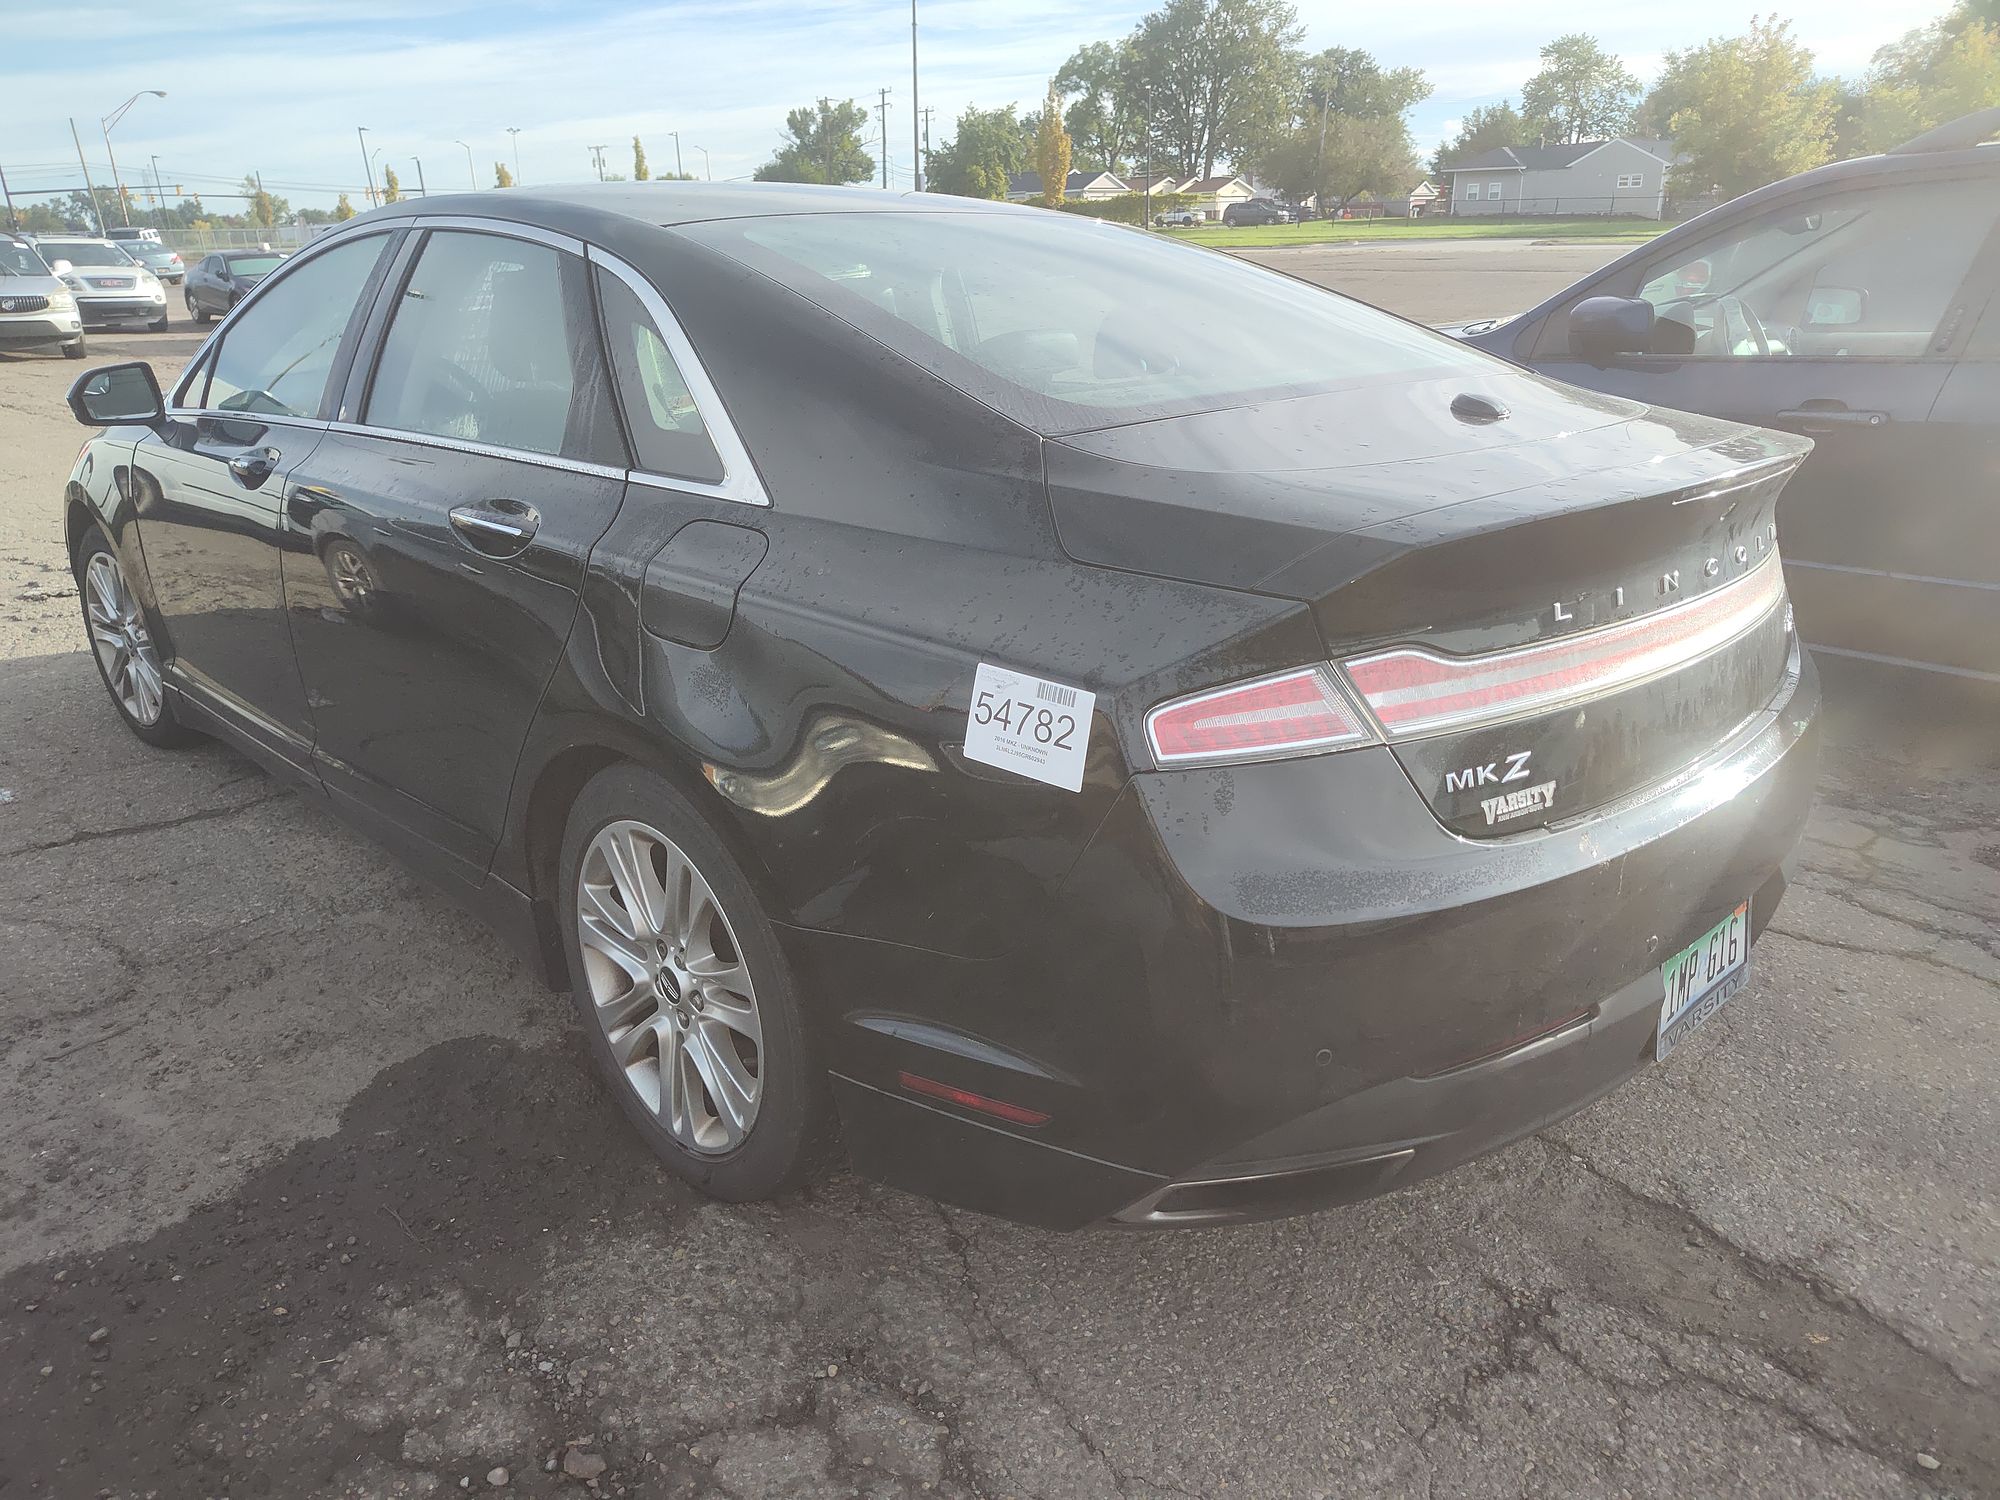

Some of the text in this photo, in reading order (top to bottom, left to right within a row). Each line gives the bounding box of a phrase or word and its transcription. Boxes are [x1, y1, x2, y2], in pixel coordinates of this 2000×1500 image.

[1553, 523, 1777, 622] LINCOLN
[974, 691, 1076, 751] 54782
[1006, 738, 1018, 747] MKZ
[1445, 751, 1532, 793] MKZ
[1480, 780, 1557, 825] VARSITY
[1706, 918, 1738, 983] G16
[1668, 971, 1742, 1046] VARSITY
